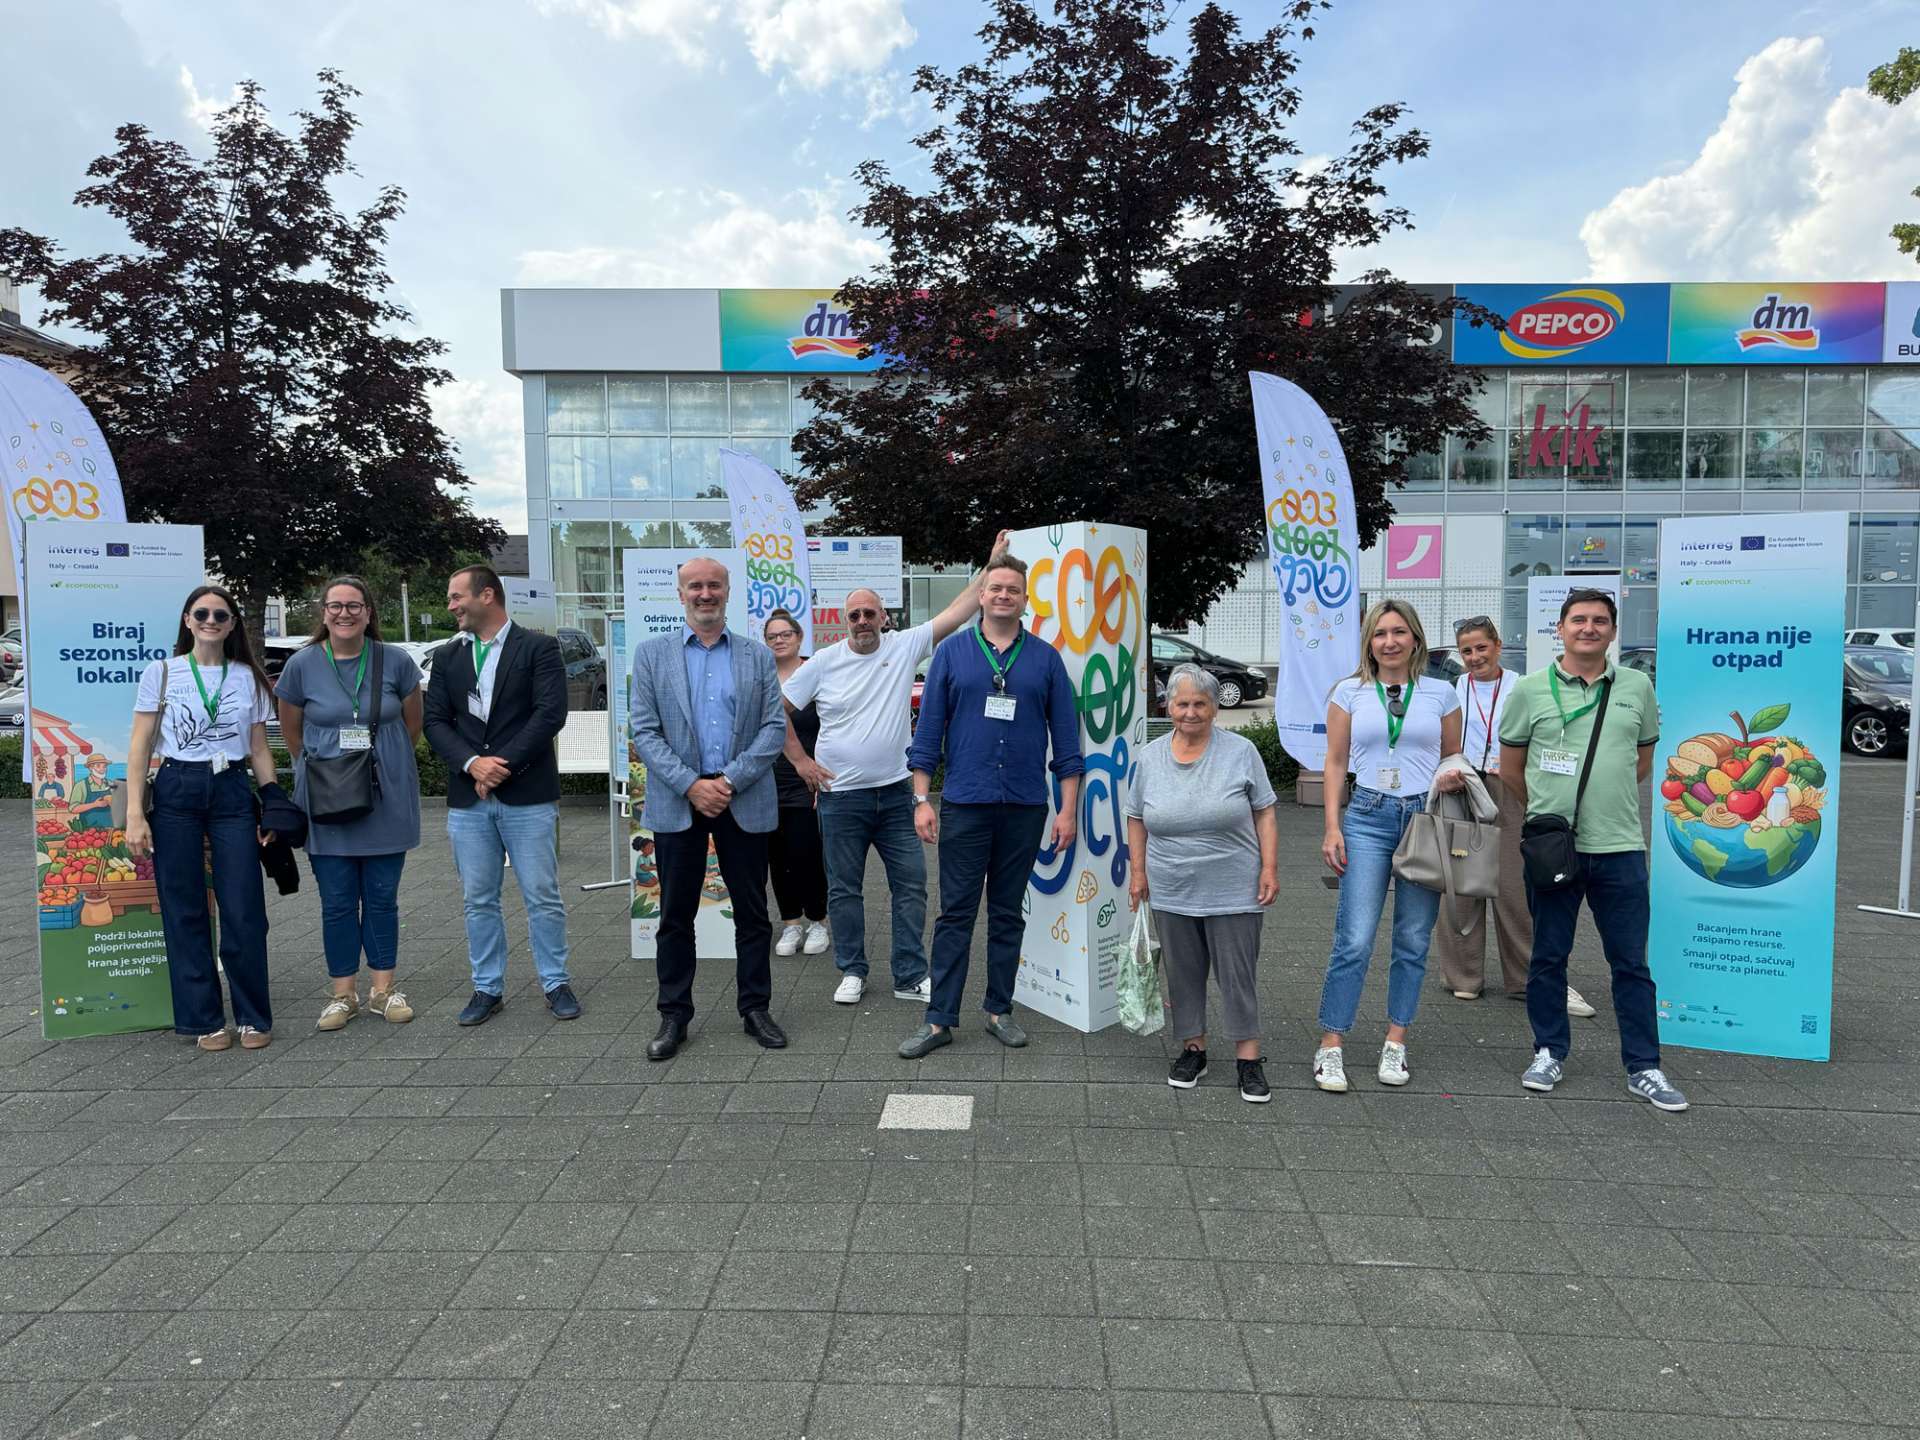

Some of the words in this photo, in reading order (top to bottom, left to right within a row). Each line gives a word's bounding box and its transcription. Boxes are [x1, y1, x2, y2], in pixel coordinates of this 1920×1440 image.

[804, 303, 858, 337] dm
[1753, 296, 1809, 329] dm
[1518, 313, 1606, 335] PEPCO
[643, 614, 678, 624] Održive
[92, 622, 145, 643] Biraj
[660, 624, 672, 633] od
[1686, 628, 1759, 645] Hrana
[1766, 625, 1812, 649] nije
[59, 644, 167, 661] sezonsko
[1712, 650, 1783, 672] otpad
[94, 931, 126, 941] Podrži
[128, 929, 164, 939] lokalne
[1697, 923, 1748, 935] Bacanjem
[1750, 927, 1782, 937] hrane
[1692, 935, 1741, 945] rasipamo
[1743, 940, 1786, 950] resurse.
[87, 959, 119, 968] Hrana
[120, 957, 130, 967] je
[131, 954, 168, 966] svježija
[1682, 948, 1717, 961] Smanji
[1719, 953, 1753, 964] otpad,
[1755, 956, 1795, 969] sačuvaj
[108, 966, 153, 977] ukusnija.
[1689, 961, 1727, 972] resurse
[1743, 966, 1788, 977] planetu.
